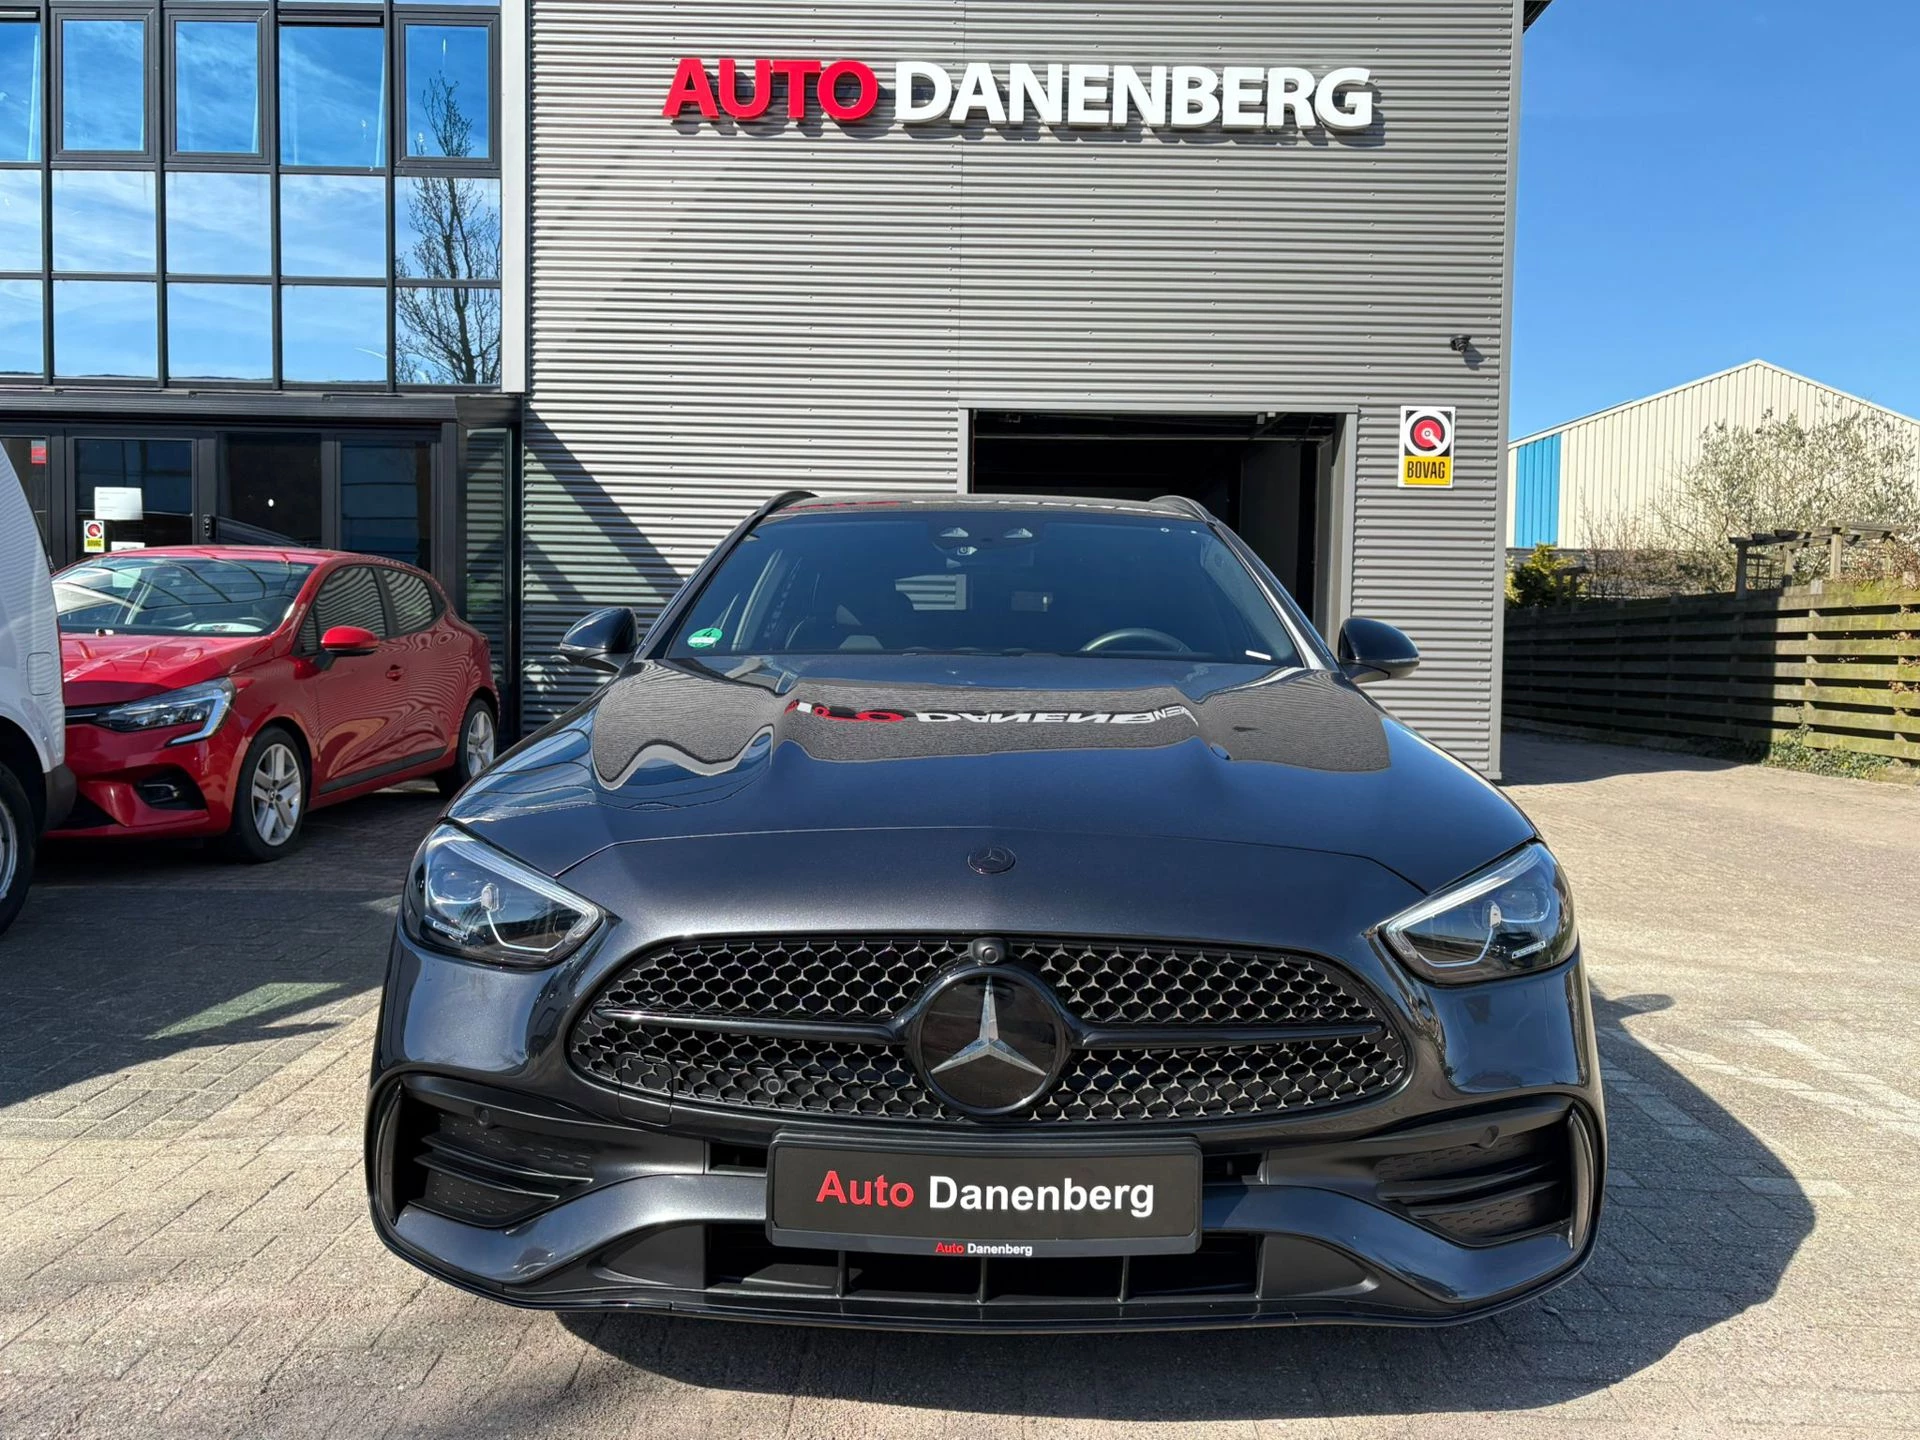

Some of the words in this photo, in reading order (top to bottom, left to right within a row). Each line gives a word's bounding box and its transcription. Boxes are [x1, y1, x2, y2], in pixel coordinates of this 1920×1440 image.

[662, 57, 879, 122] AUTO
[895, 60, 1373, 131] DANENBERG
[1407, 460, 1446, 479] BOVAG
[816, 1169, 915, 1209] Auto
[929, 1175, 1155, 1218] Danenberg
[935, 1242, 965, 1254] Auto
[967, 1243, 1033, 1257] Danenberg
